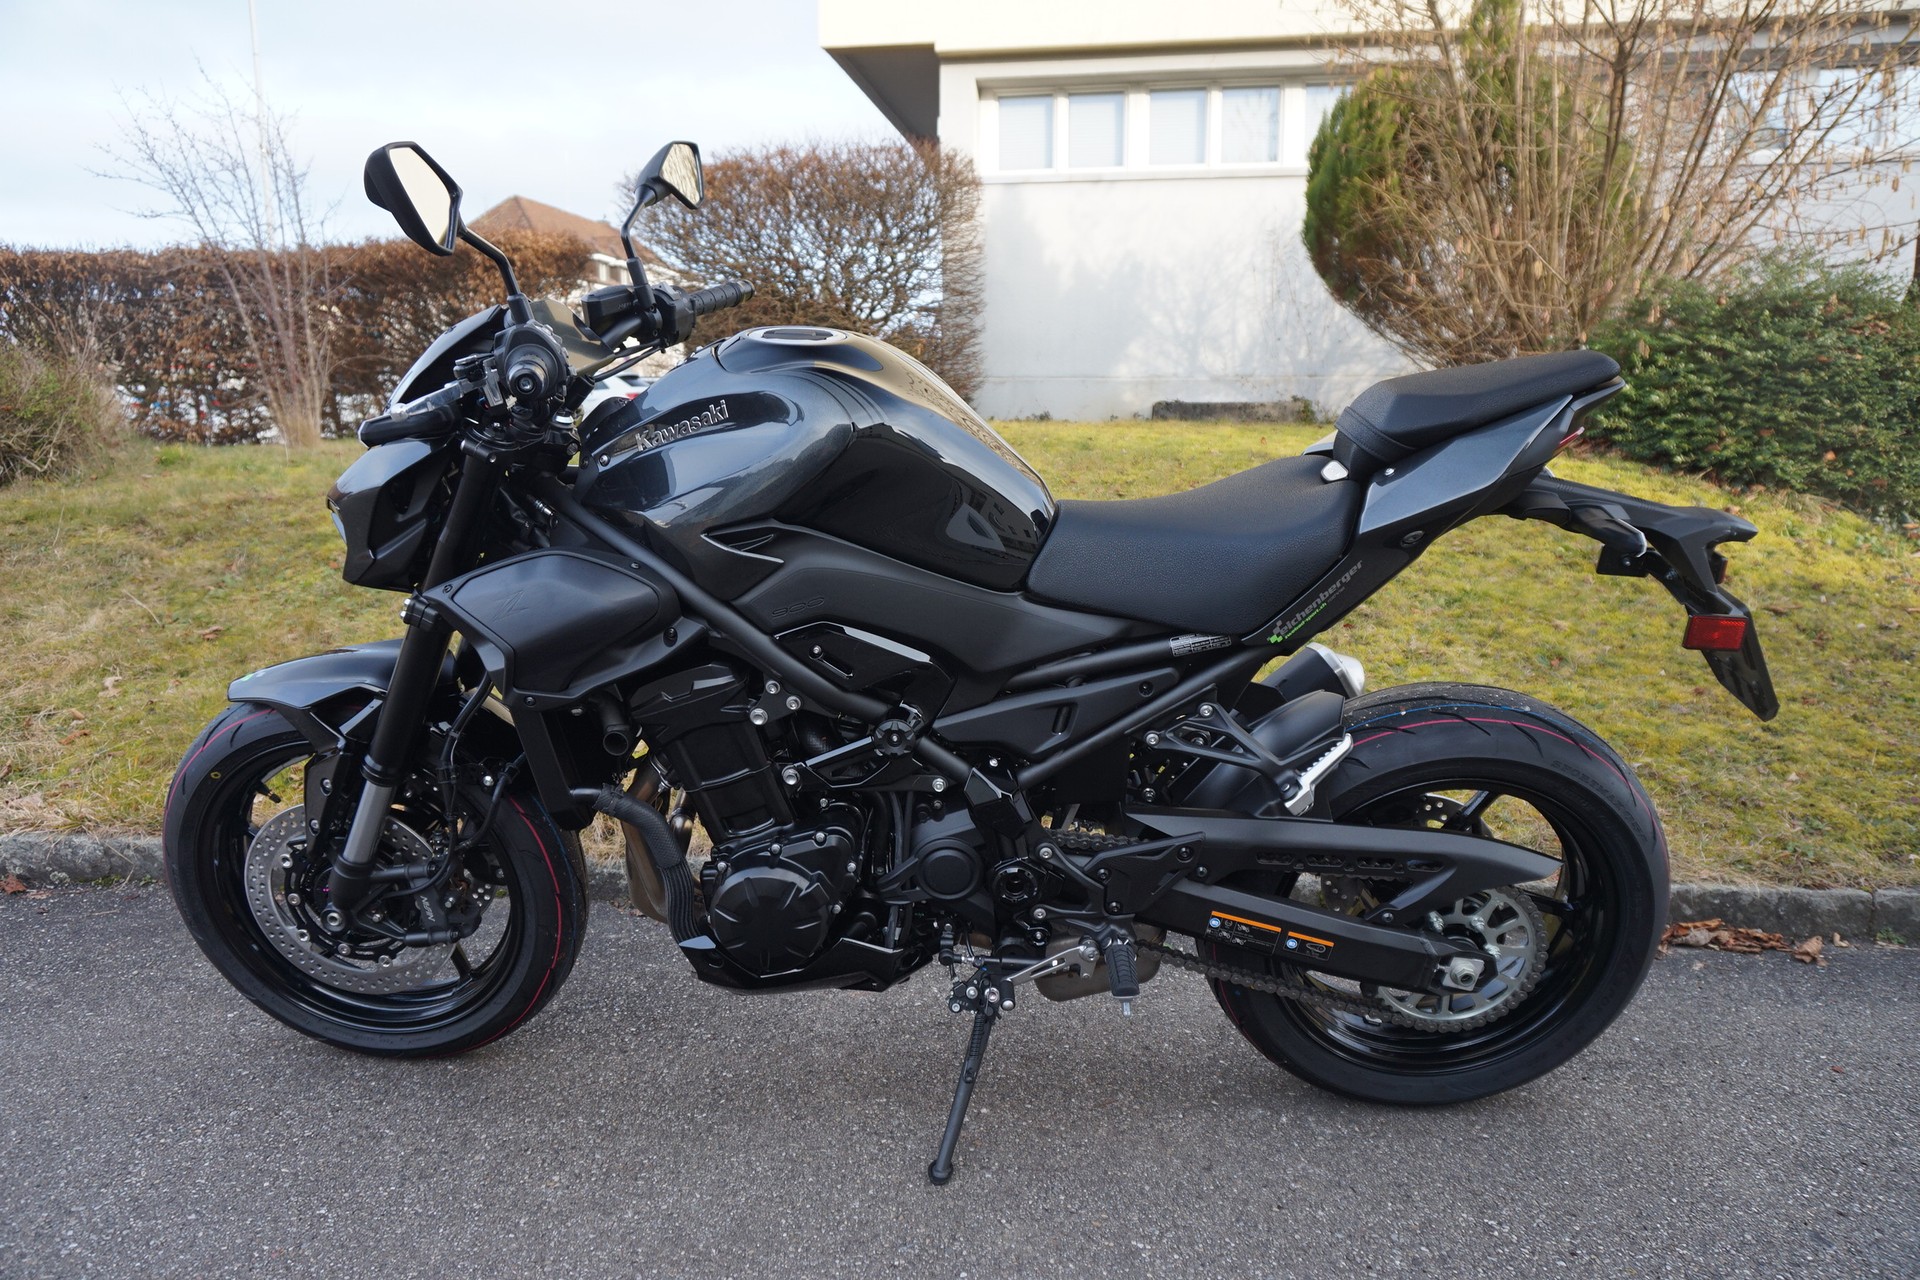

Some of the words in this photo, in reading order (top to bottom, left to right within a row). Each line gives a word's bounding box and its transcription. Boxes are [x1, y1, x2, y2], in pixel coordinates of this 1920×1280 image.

[634, 399, 729, 451] Kawasaki
[772, 597, 824, 618] 900
[1280, 560, 1362, 635] eichenberger
